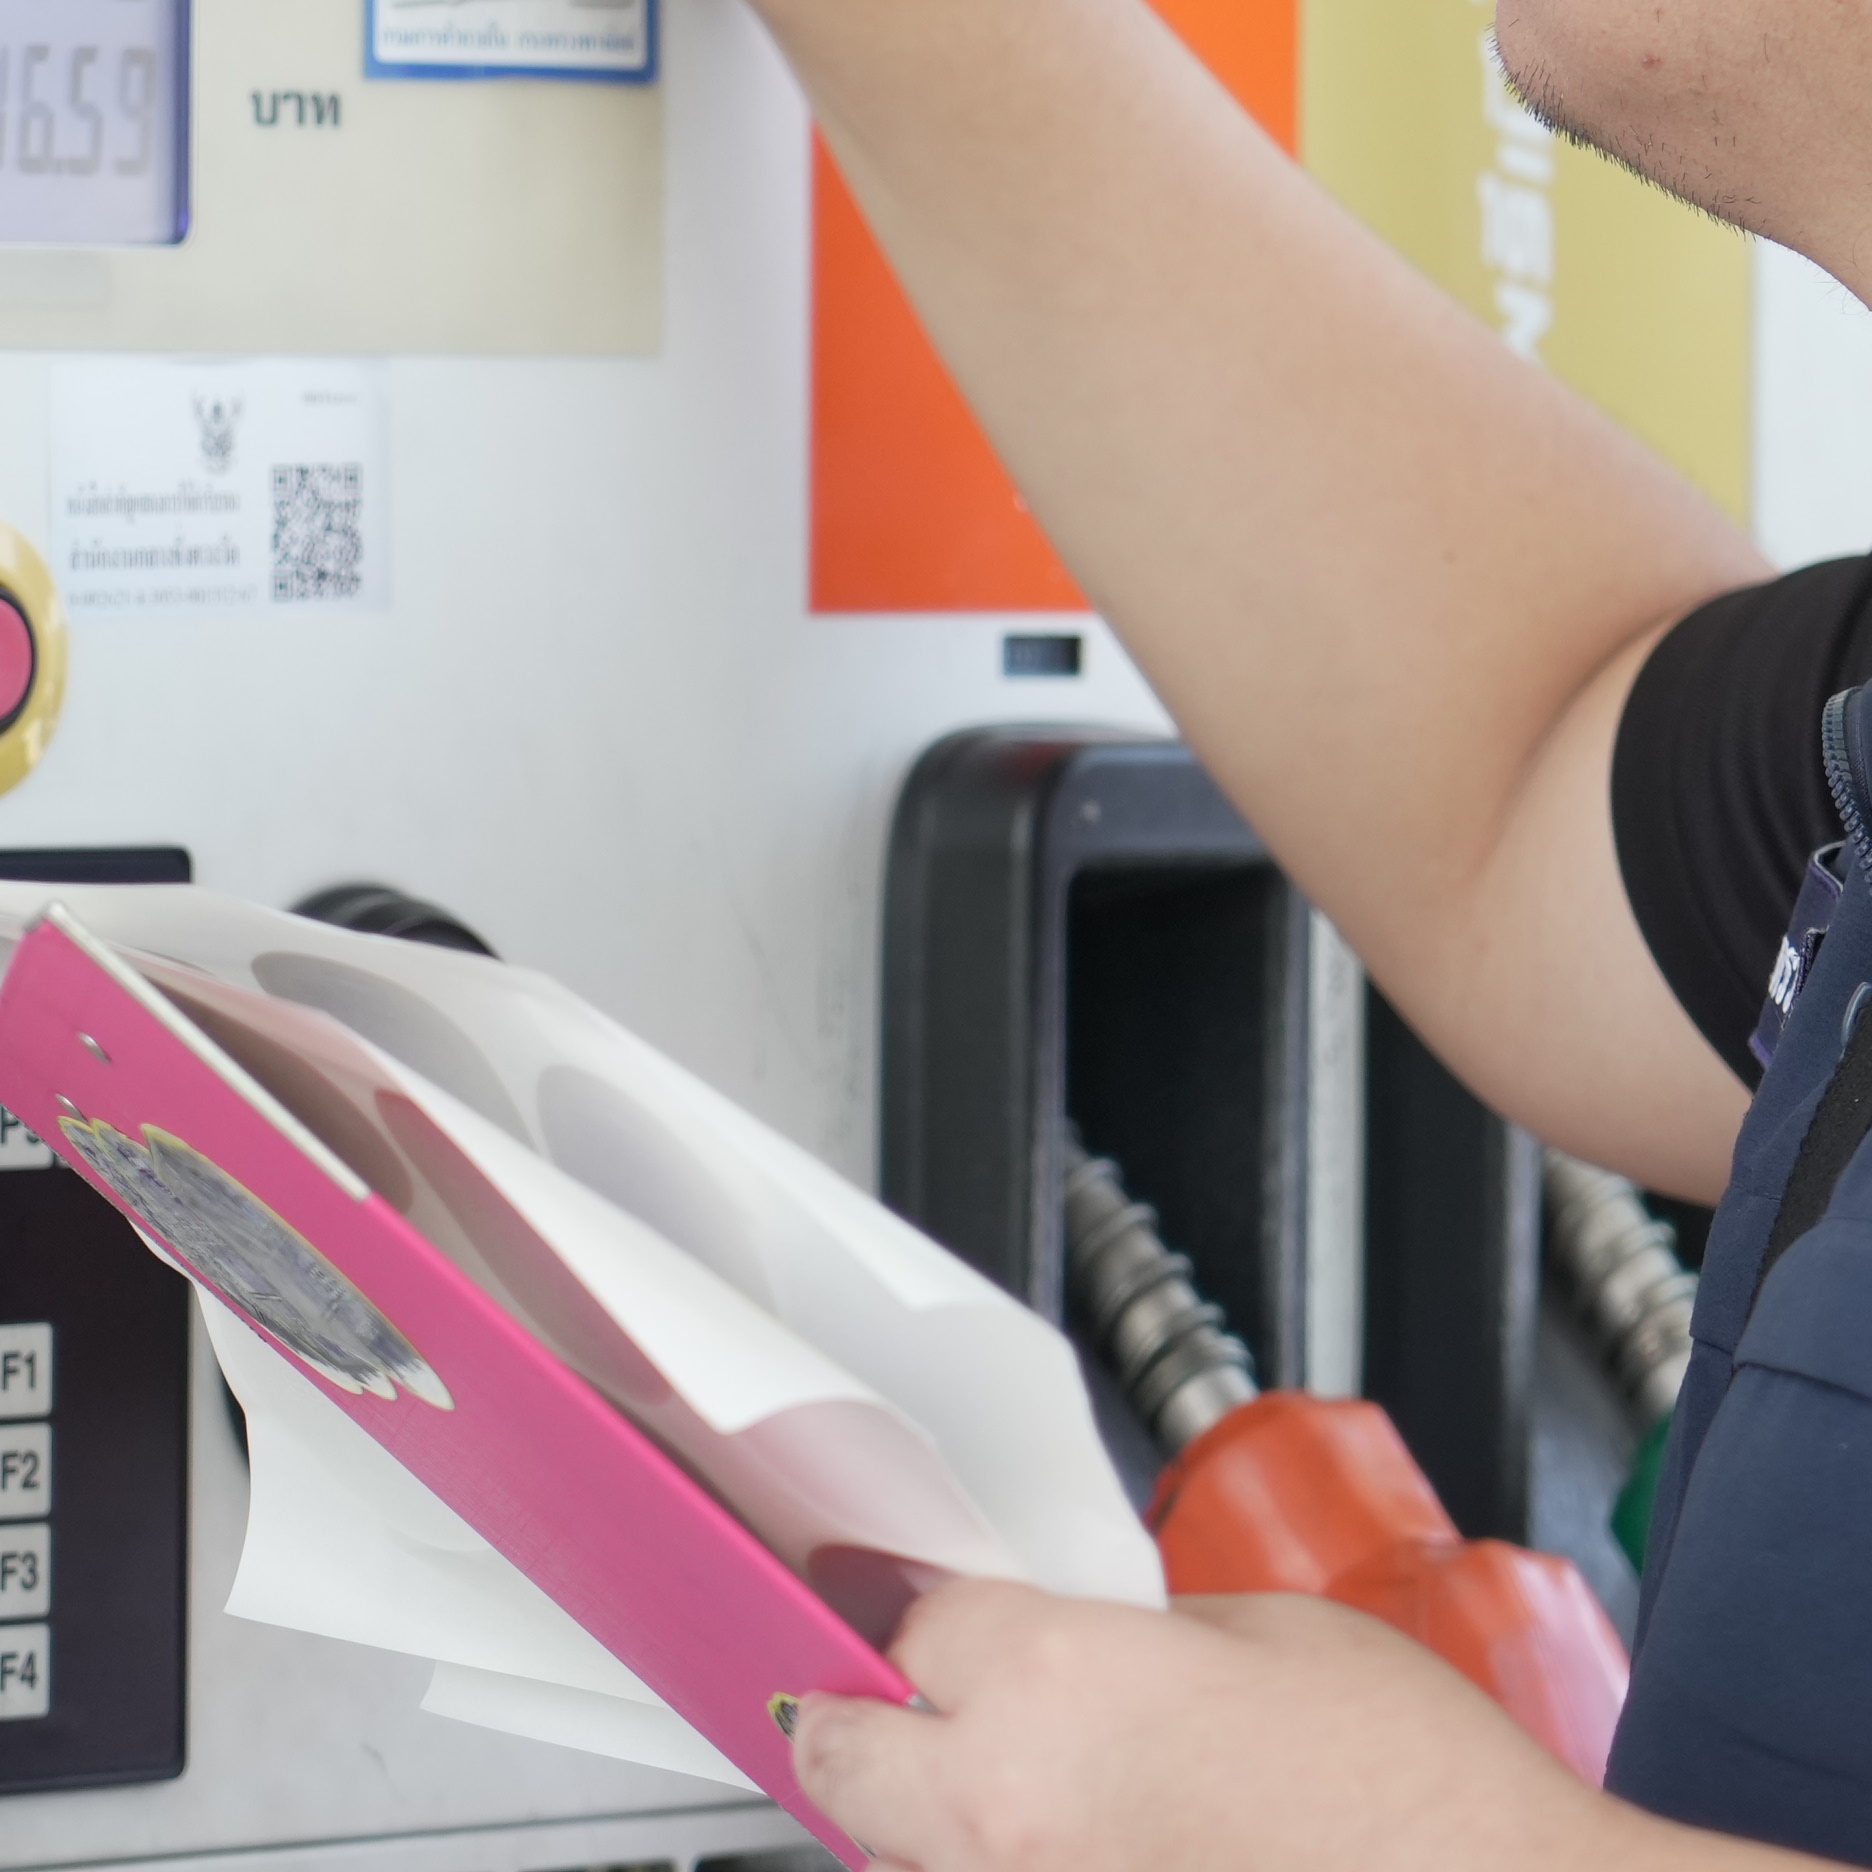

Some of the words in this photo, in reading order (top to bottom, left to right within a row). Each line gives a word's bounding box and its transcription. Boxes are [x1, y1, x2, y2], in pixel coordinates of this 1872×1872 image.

[250, 90, 342, 128] บาท
[0, 1100, 45, 1145] P
[1, 1350, 37, 1392] F1
[0, 1449, 41, 1493] F2
[0, 1549, 40, 1593] F3
[0, 1650, 39, 1693] F4
